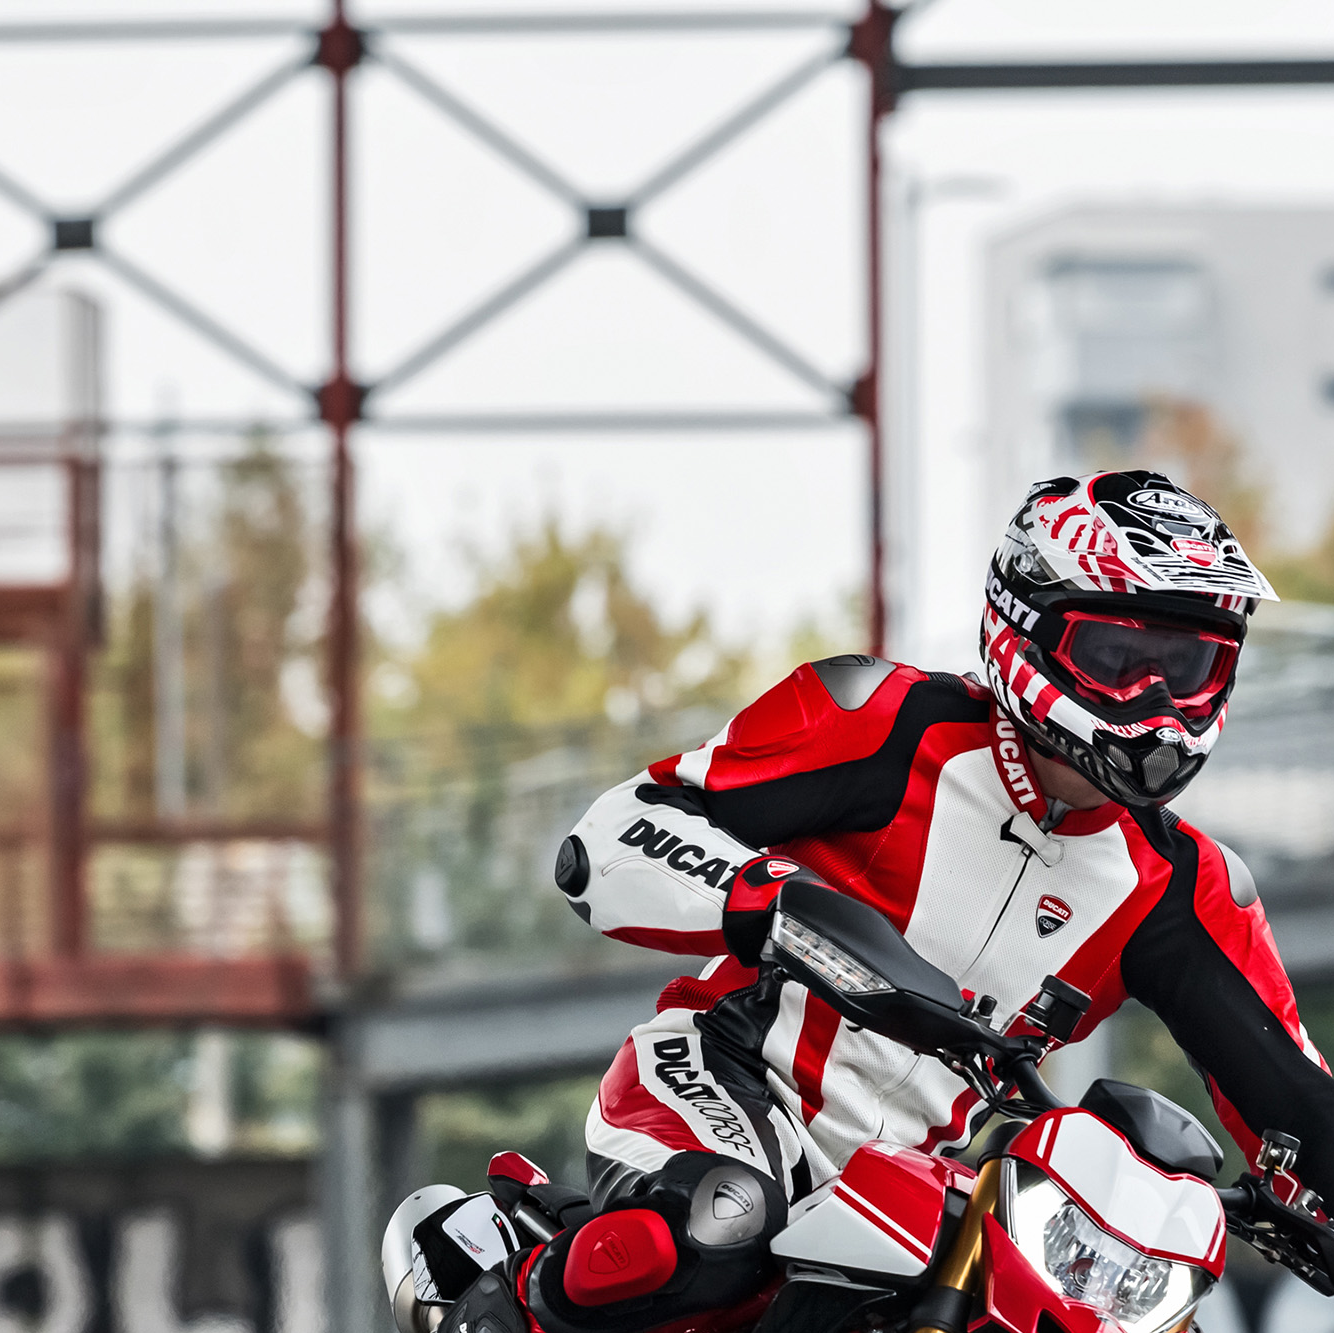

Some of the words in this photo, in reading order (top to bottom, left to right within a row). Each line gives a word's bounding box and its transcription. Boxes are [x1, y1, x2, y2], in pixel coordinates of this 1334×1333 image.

[1176, 542, 1213, 553] DUCATI
[1042, 899, 1070, 918] DUCATI
[691, 1101, 756, 1157] CORSE
[721, 1184, 751, 1208] DUCATI
